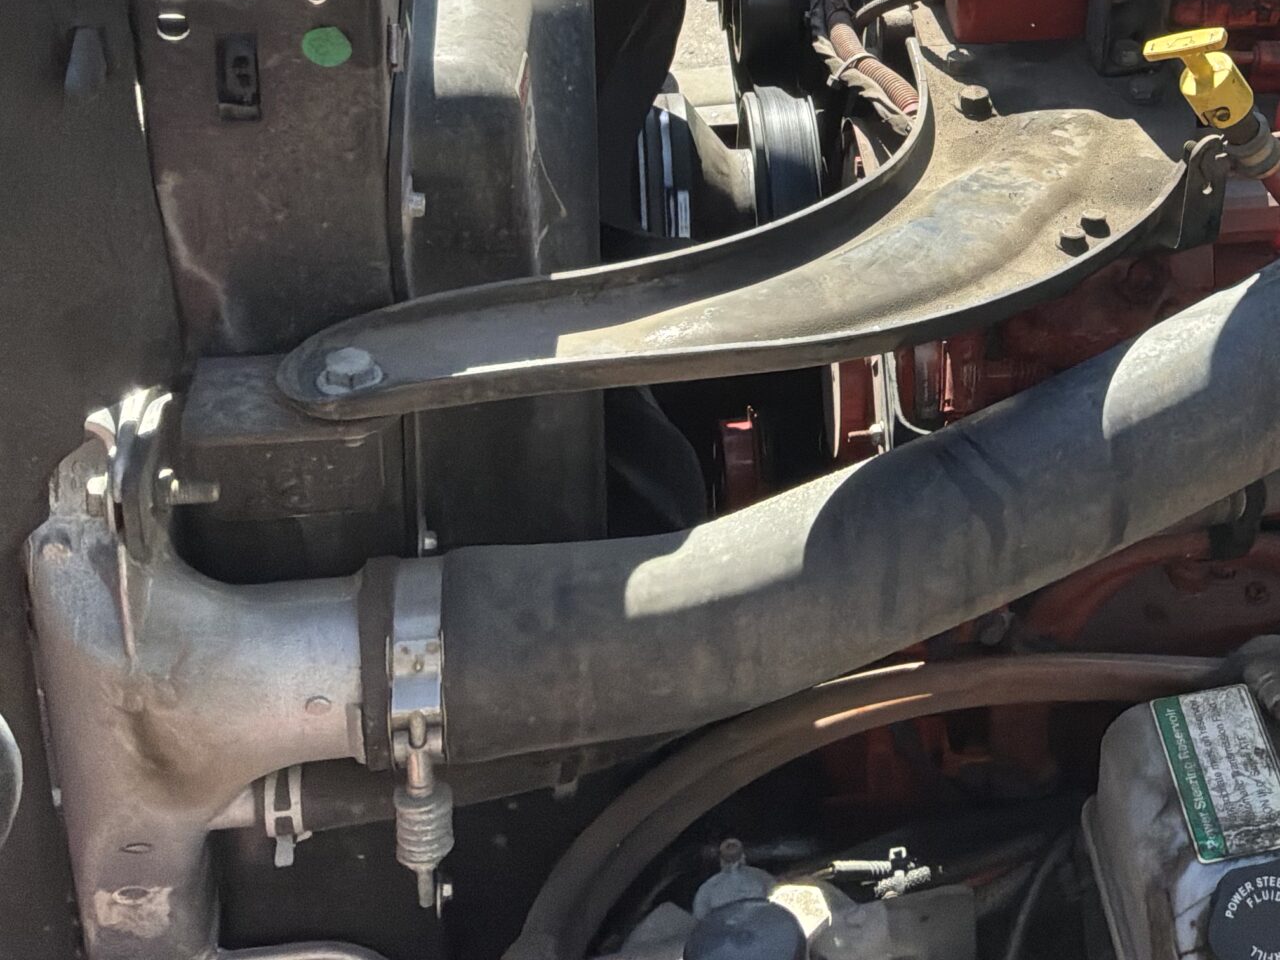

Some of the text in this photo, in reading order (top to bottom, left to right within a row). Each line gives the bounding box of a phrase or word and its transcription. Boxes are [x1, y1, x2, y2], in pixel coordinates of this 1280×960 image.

[1165, 707, 1189, 760] Reservoir
[1184, 761, 1206, 811] Steering
[1225, 881, 1255, 919] POWER
